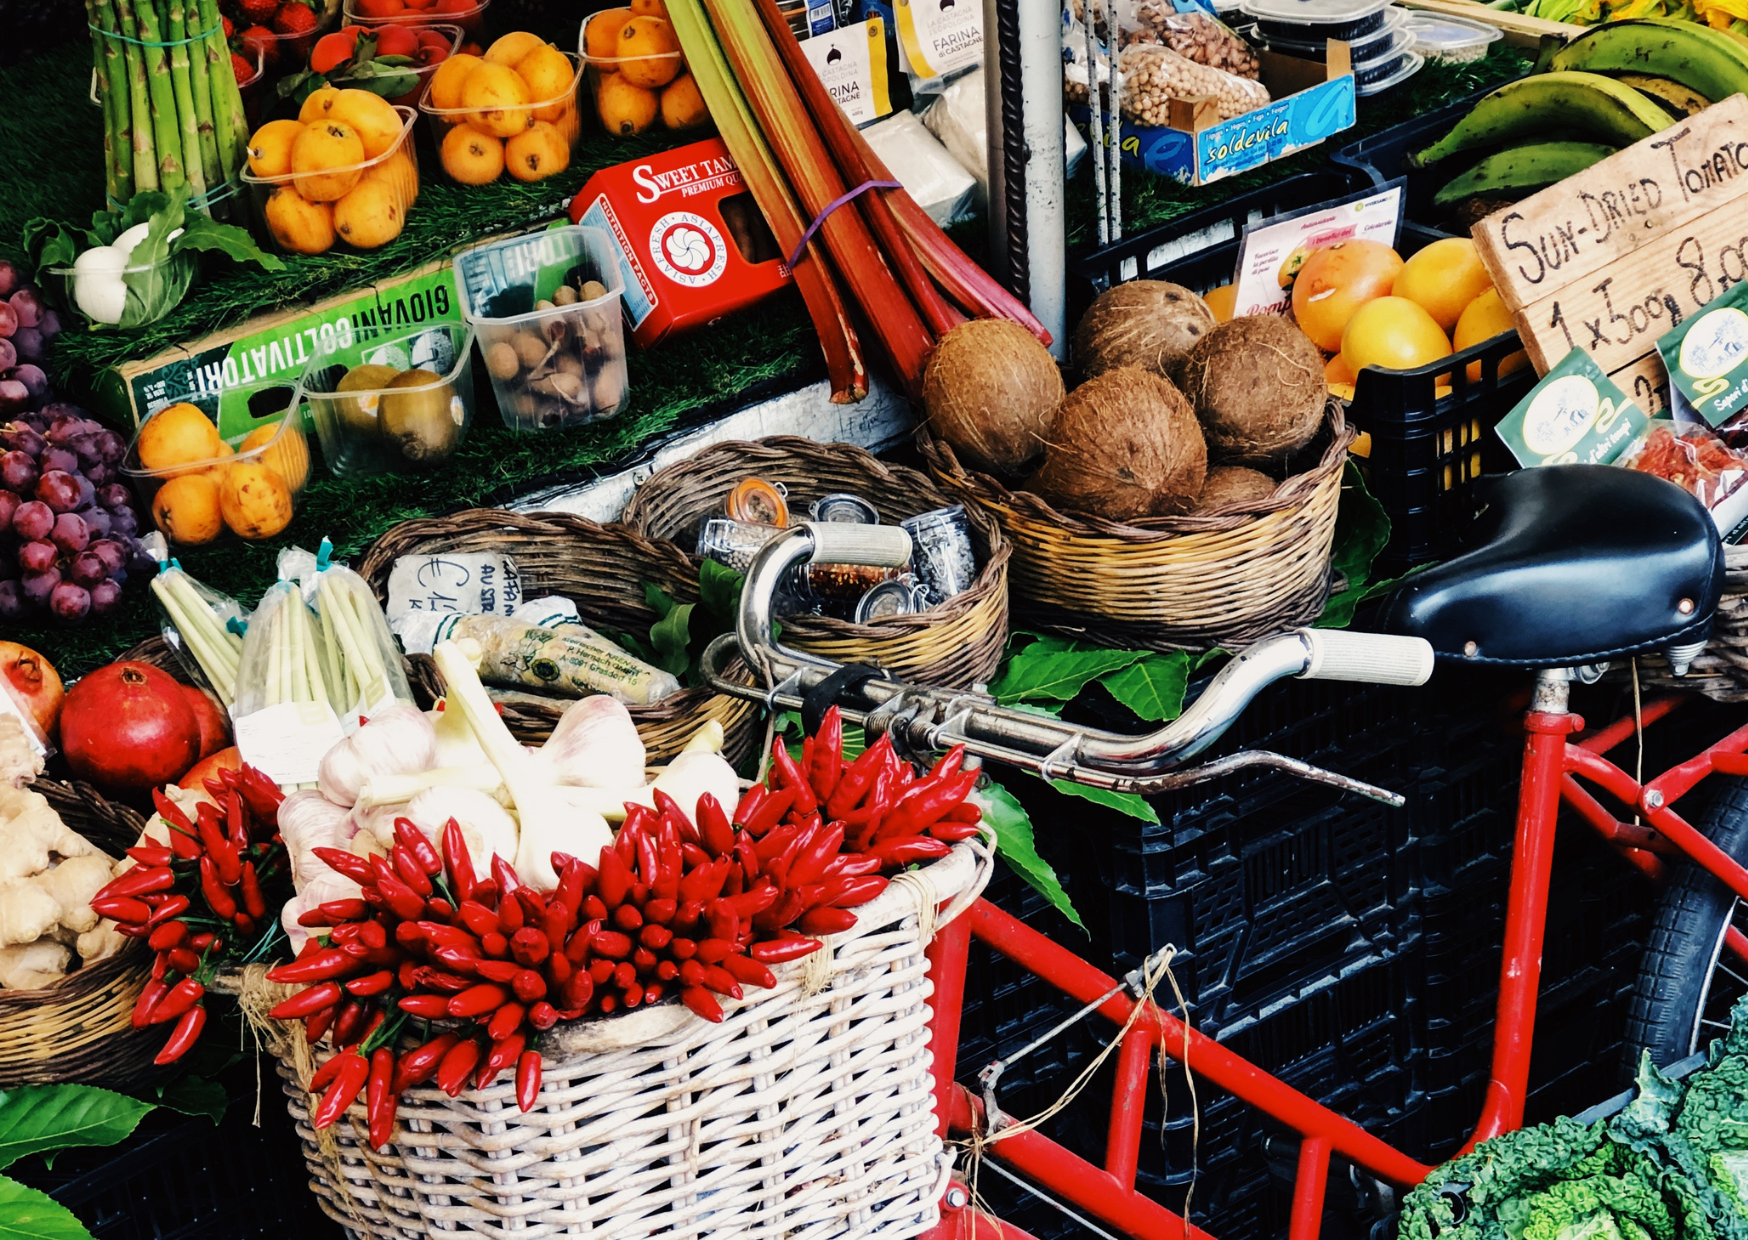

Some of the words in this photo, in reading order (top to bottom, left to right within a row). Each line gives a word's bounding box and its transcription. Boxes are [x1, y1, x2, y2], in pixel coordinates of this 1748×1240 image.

[933, 26, 980, 51] FARINA
[945, 36, 983, 55] CASTAGNE
[829, 81, 860, 98] RINA
[837, 92, 861, 105] TAGNE
[1205, 116, 1289, 165] soldevila
[681, 178, 725, 198] PREMIUM
[601, 201, 635, 262] NUTRITION
[633, 265, 655, 301] FACTS
[352, 284, 450, 336] GIOVANI
[196, 317, 351, 400] COLTIVATORI
[1713, 386, 1742, 412] Sapori
[480, 564, 495, 613] AUSTR
